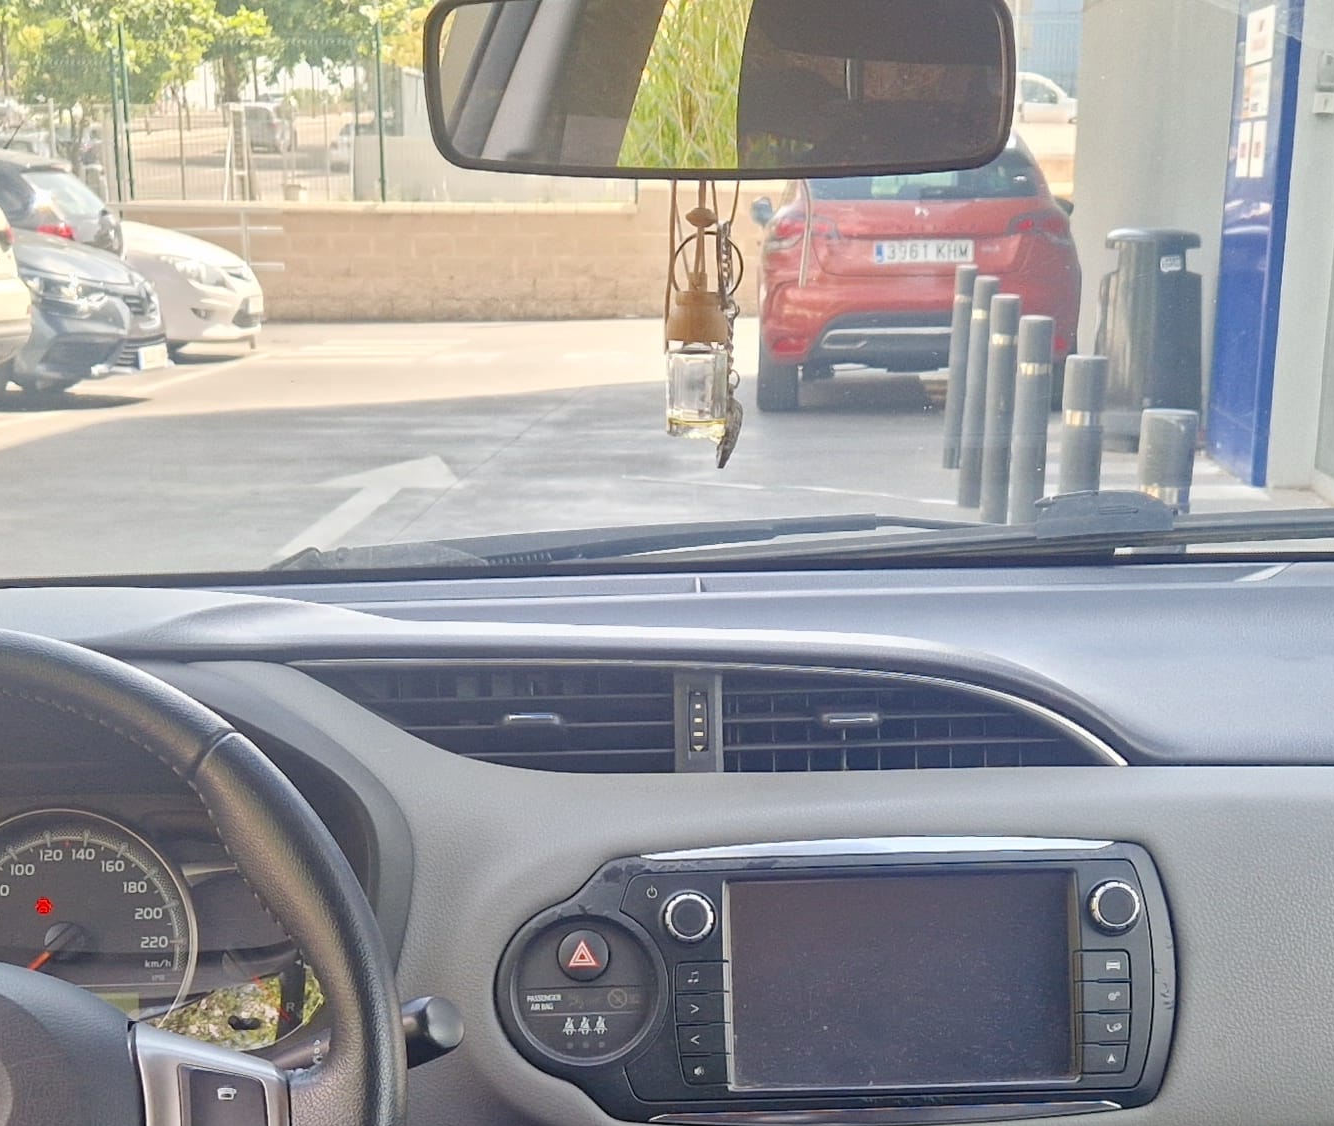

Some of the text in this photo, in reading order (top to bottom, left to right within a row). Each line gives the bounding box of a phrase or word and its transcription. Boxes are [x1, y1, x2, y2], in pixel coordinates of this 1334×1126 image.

[39, 849, 63, 861] 120
[71, 848, 96, 860] 140
[10, 864, 35, 876] 100
[101, 860, 125, 872] 160
[123, 881, 147, 893] 180
[134, 907, 163, 919] 200
[140, 936, 168, 948] 220
[144, 959, 171, 969] km/h
